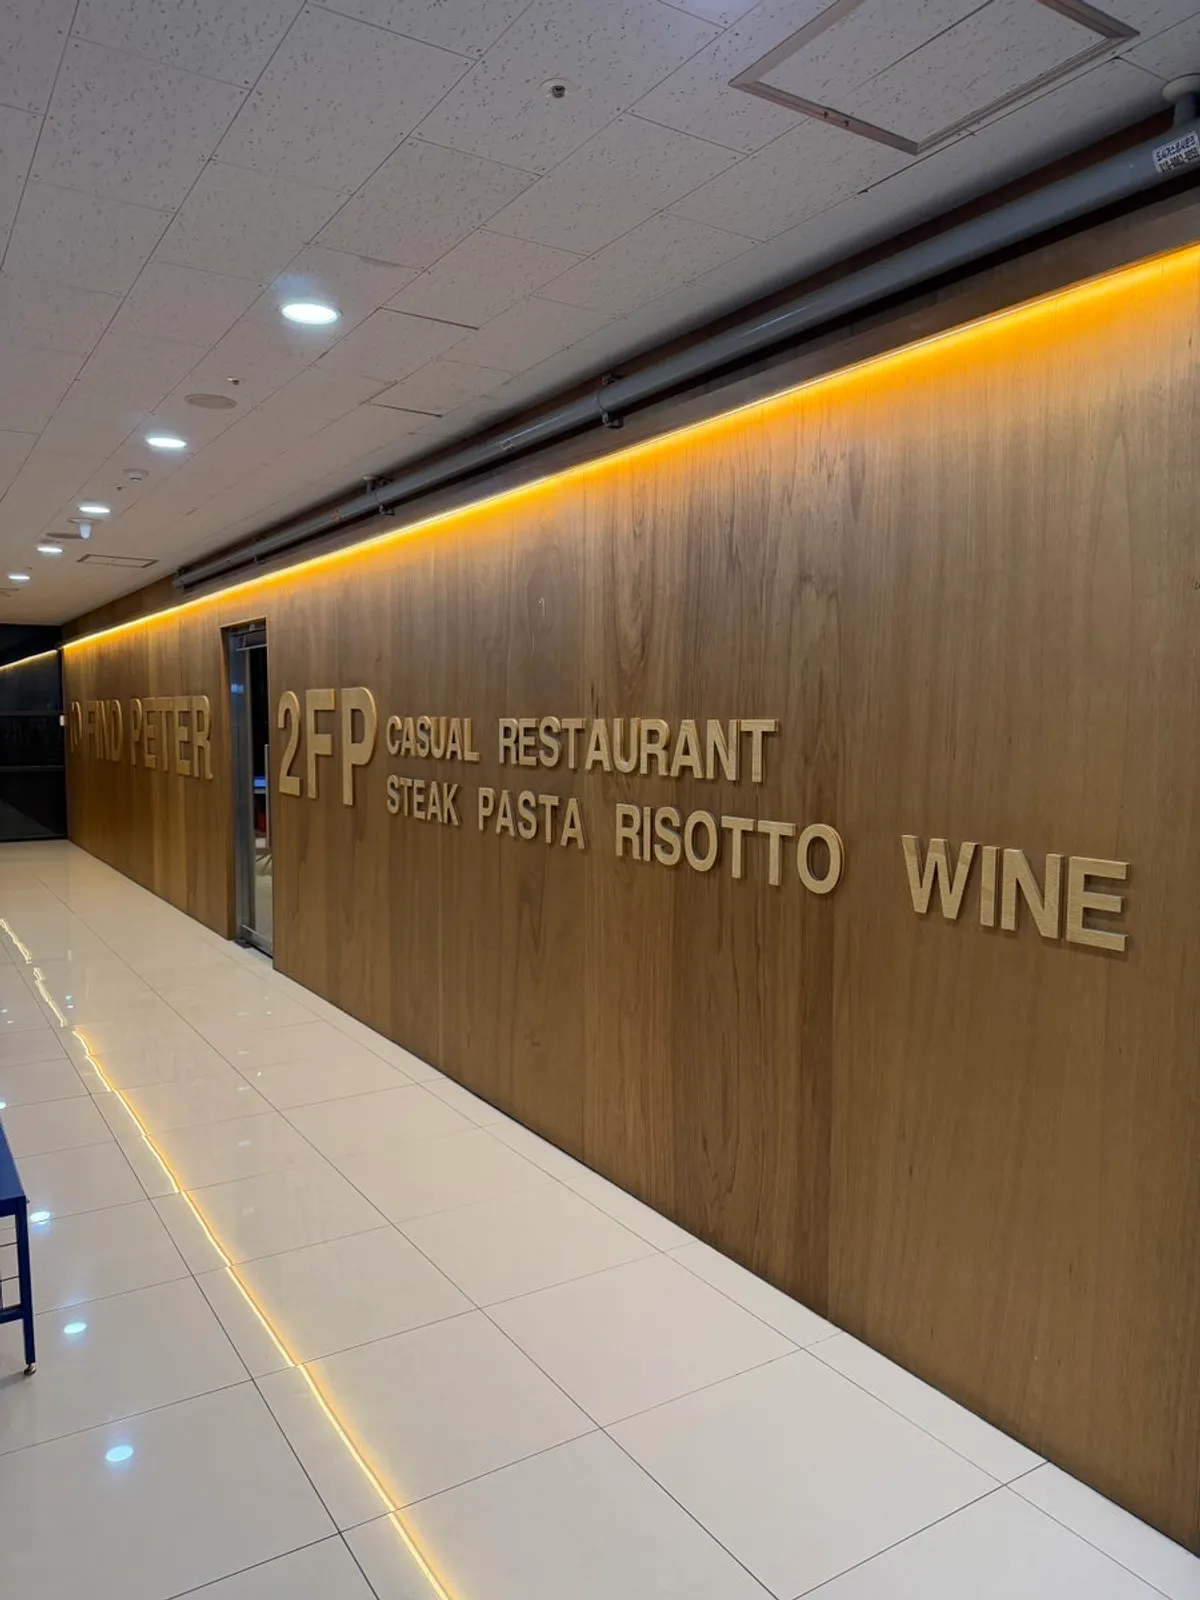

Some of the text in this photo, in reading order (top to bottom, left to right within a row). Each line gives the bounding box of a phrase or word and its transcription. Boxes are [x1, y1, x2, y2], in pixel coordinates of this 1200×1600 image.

[131, 695, 213, 780] PETER
[278, 687, 377, 806] 2FP
[386, 715, 778, 783] CASUAL RESTAURANT
[386, 774, 1130, 953] STEAK PASTA RISOTTO WINE
